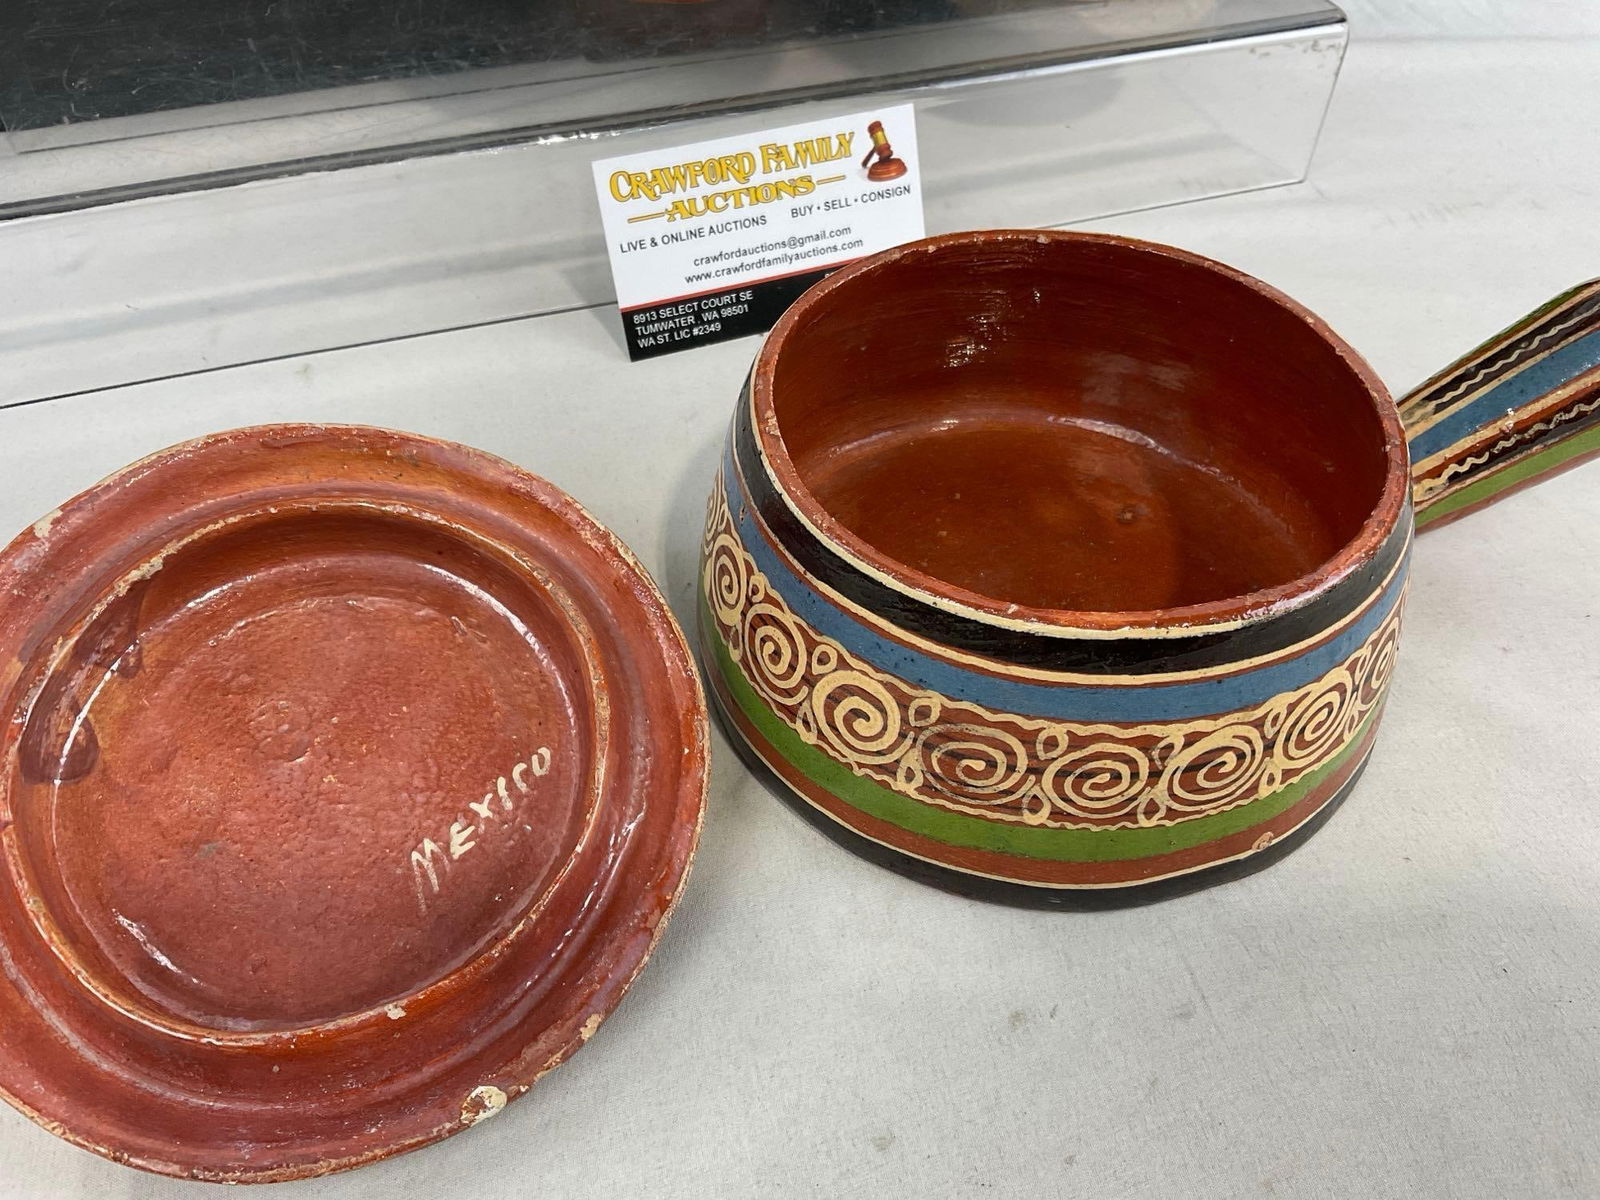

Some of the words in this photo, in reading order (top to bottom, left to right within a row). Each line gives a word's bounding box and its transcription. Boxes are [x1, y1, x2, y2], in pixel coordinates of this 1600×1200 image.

[609, 152, 756, 202] CRAWFORD
[759, 131, 855, 174] FAMILY
[664, 175, 816, 221] AUCTIONS
[791, 204, 814, 219] BUY
[823, 197, 852, 212] SELL
[861, 184, 912, 204] CONSIGN
[620, 237, 647, 253] LIVE
[650, 237, 659, 247] &
[661, 227, 706, 245] ONLINE
[708, 215, 768, 236] AUCTIONS
[693, 225, 852, 267] crawfordauctions@gmail.com
[684, 238, 864, 284] www.crawfordfamilyauctions.com
[633, 311, 657, 325] 8913
[659, 301, 700, 318] SELECT
[701, 295, 737, 310] COURT
[739, 290, 753, 302] SE
[702, 311, 719, 323] WA
[721, 304, 749, 318] 98501
[638, 336, 655, 349] WA
[656, 335, 672, 346] ST.
[675, 329, 690, 341] LIC
[692, 322, 721, 338] #2349
